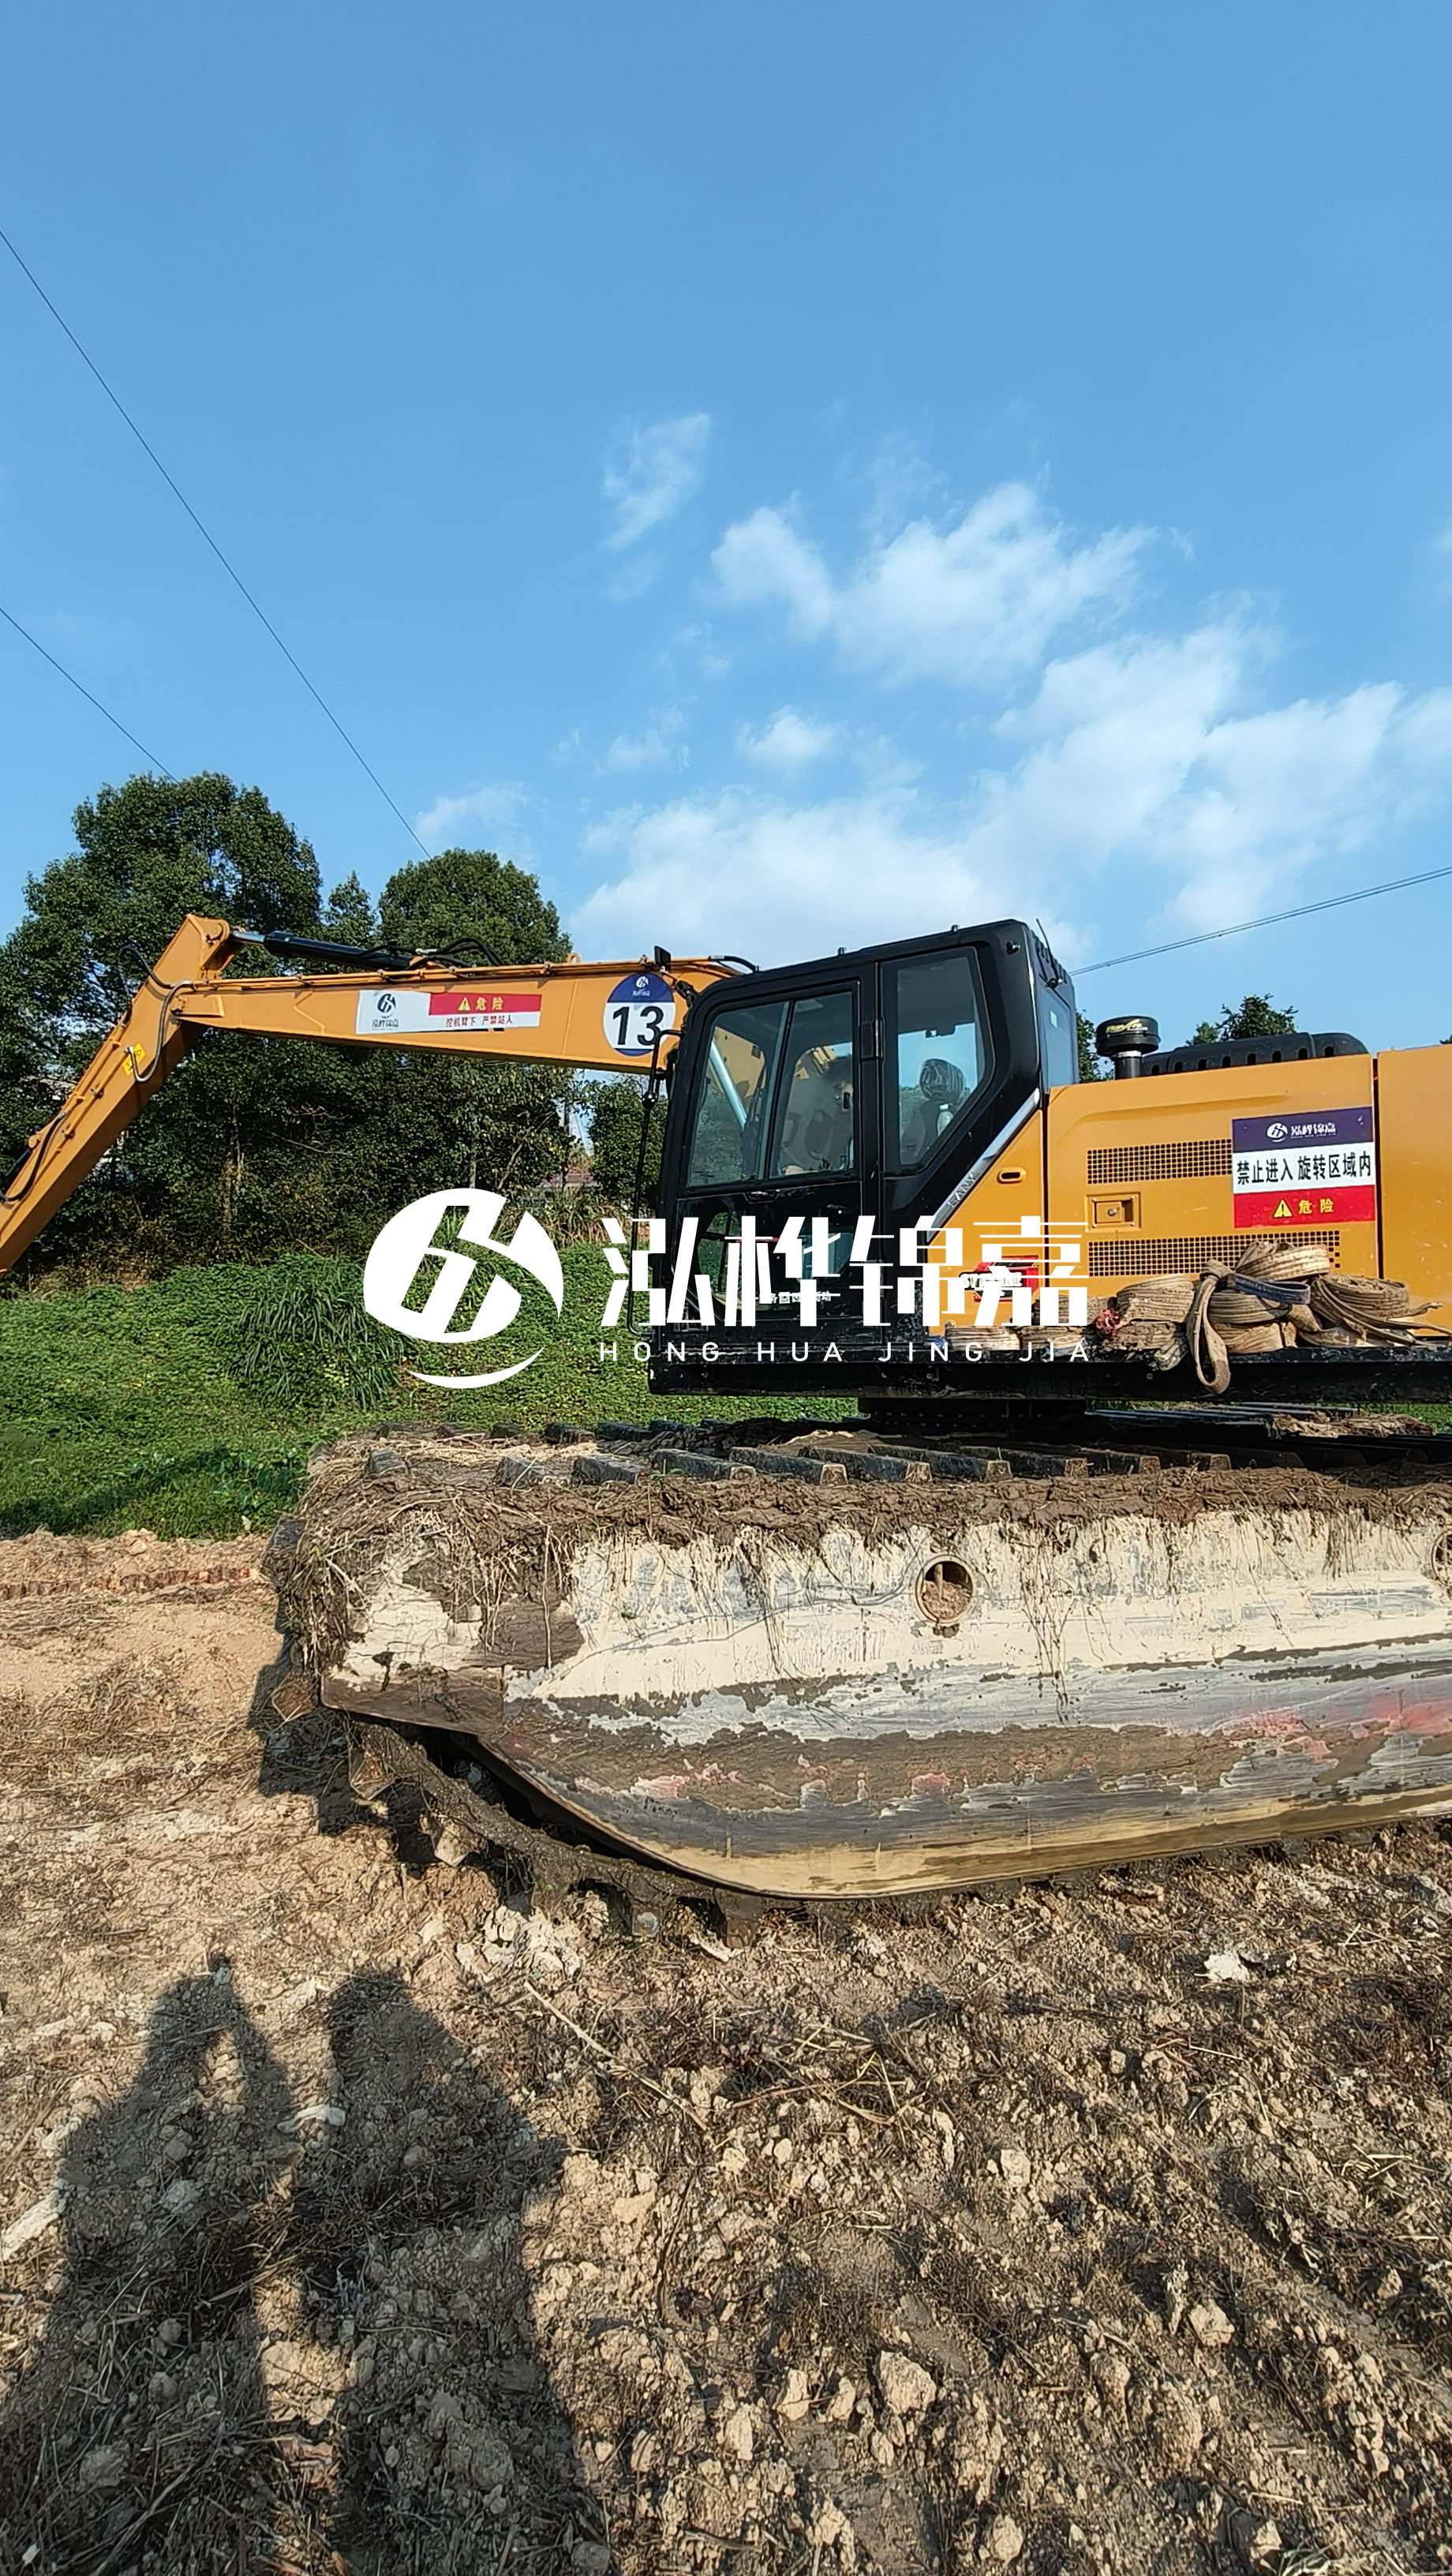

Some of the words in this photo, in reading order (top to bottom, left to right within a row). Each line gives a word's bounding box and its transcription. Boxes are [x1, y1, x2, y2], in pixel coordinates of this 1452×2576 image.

[476, 997, 503, 1011] 危险
[612, 1005, 664, 1046] 13
[1298, 1198, 1334, 1215] 危险
